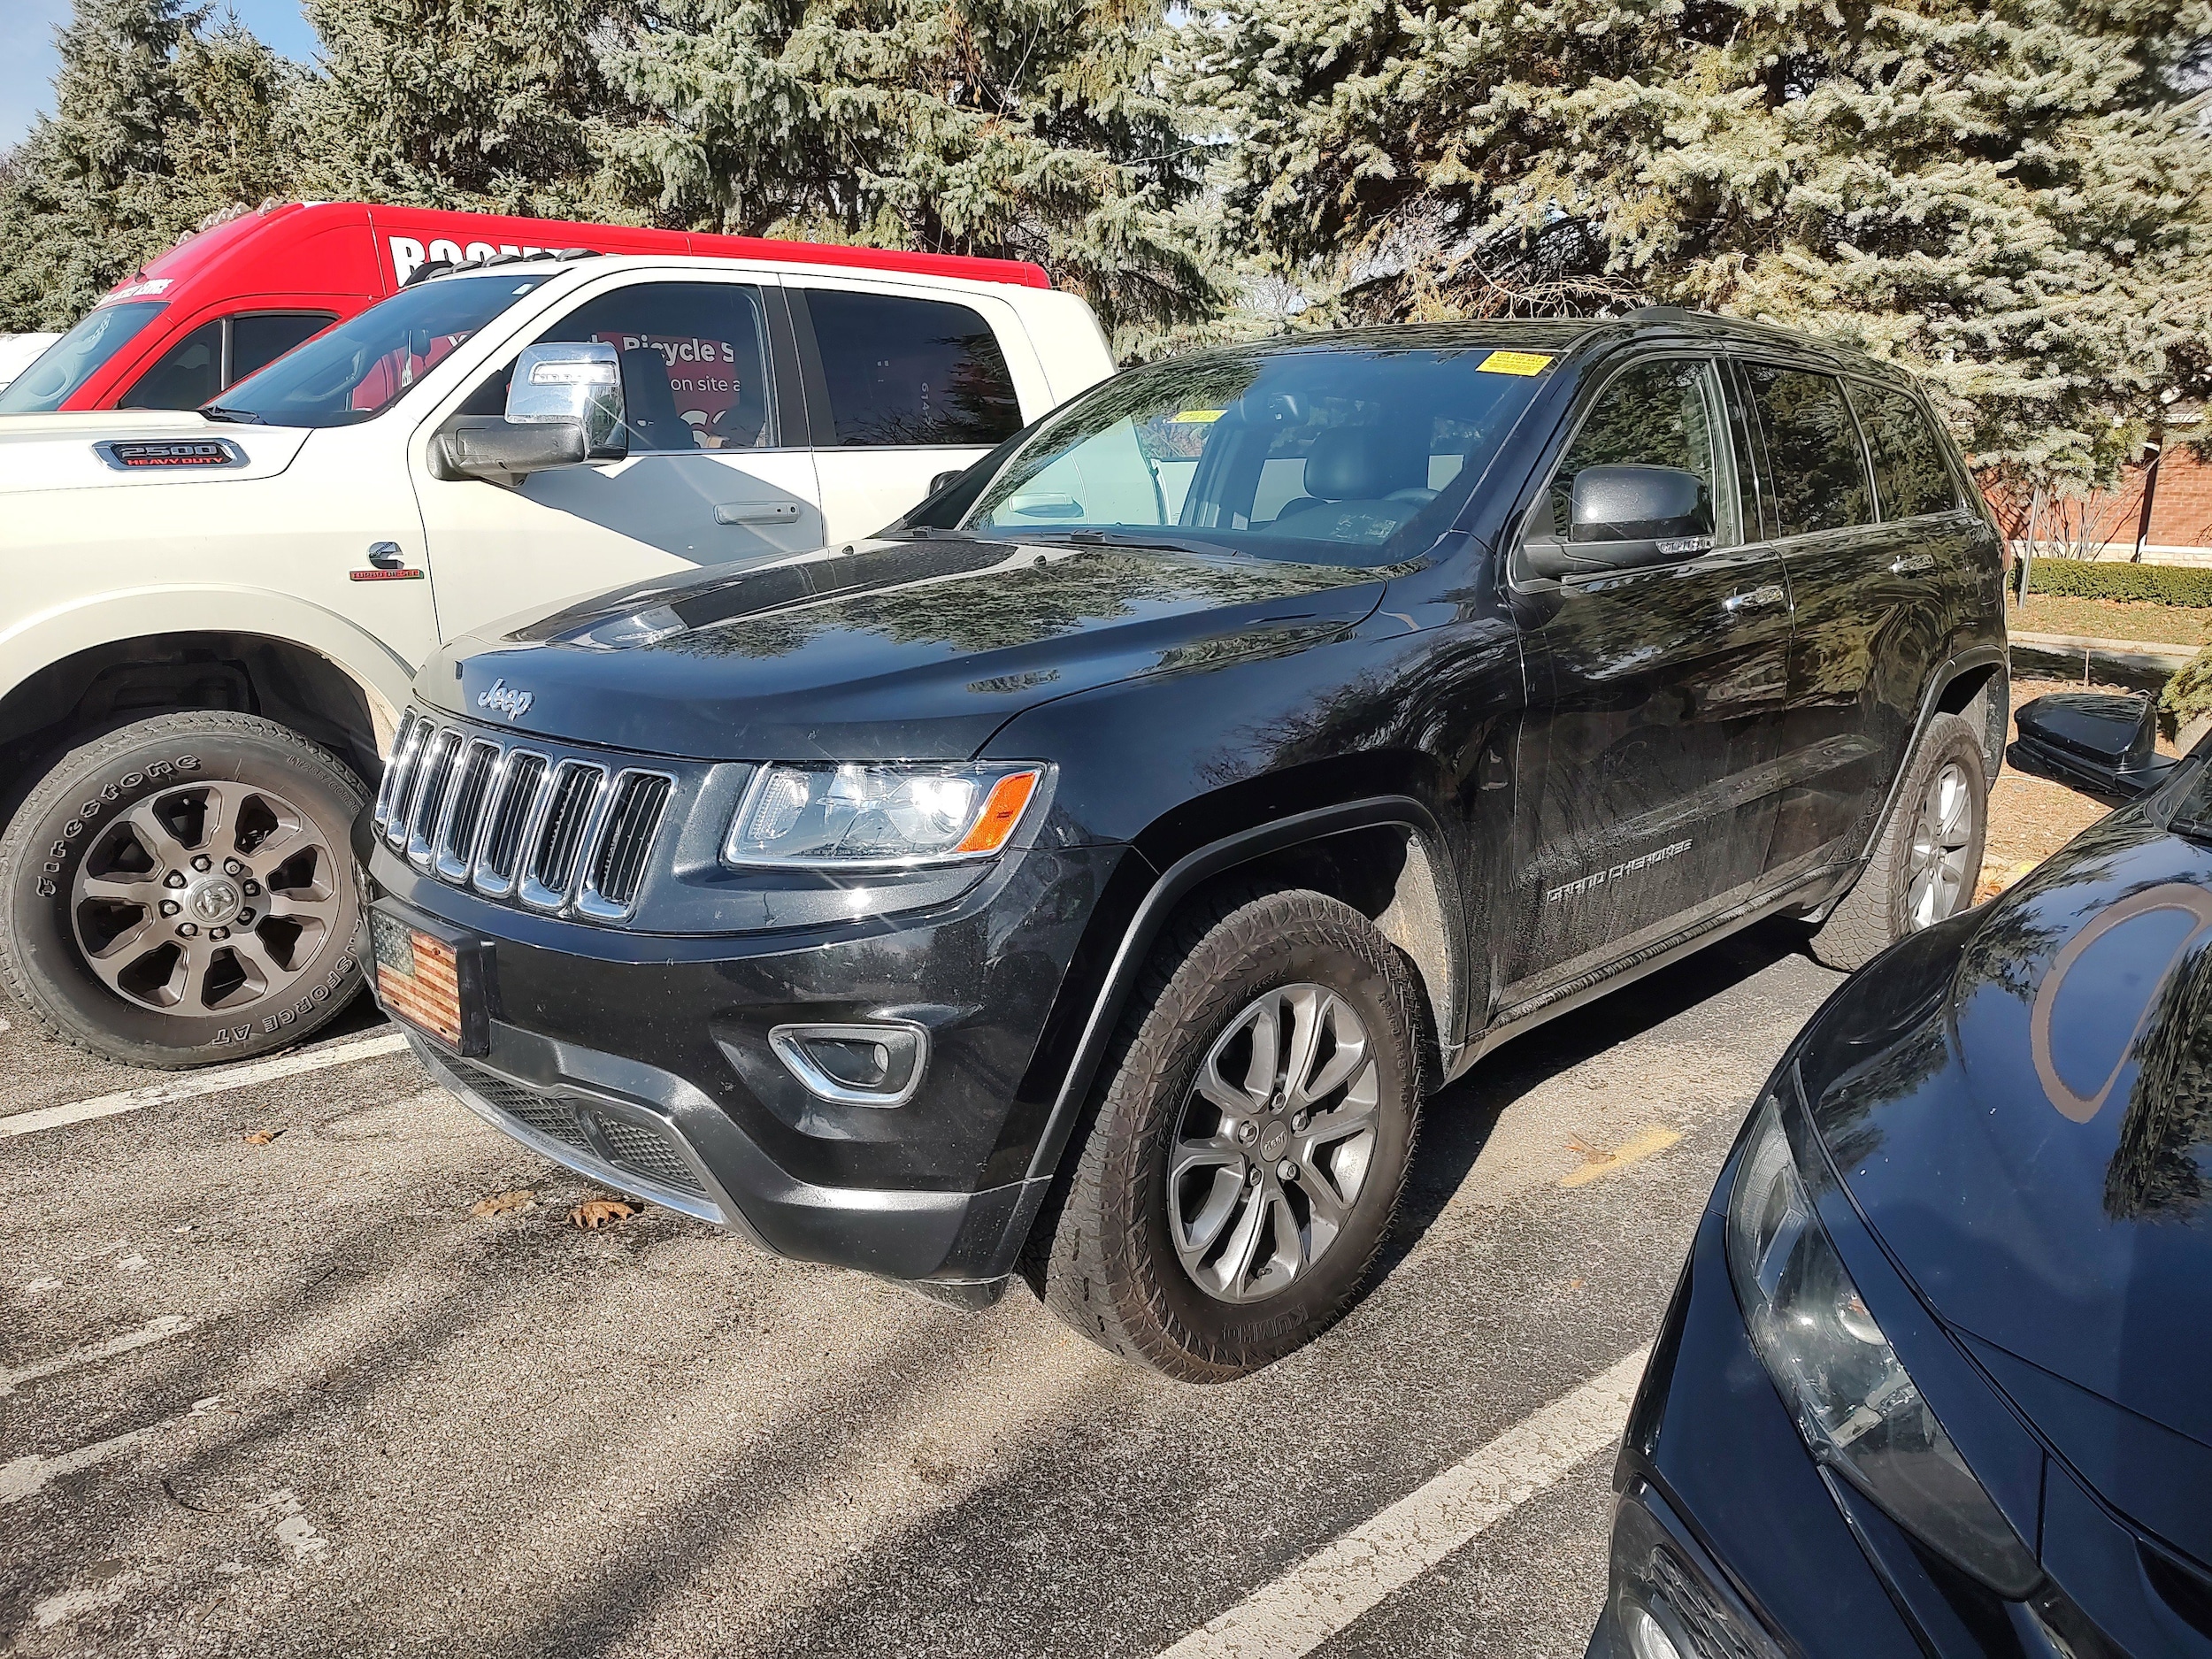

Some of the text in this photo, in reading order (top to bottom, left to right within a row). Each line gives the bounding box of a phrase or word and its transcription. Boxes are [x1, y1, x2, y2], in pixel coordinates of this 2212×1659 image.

[670, 378, 694, 393] on
[697, 375, 729, 393] site
[121, 445, 219, 458] 2500
[127, 457, 224, 466] HEAVY DUTY
[477, 678, 535, 722] Jeep
[1547, 838, 1694, 903] GRAND CHEROKEE
[211, 1022, 254, 1046] AT
[1263, 1130, 1287, 1151] Jeep
[1222, 1302, 1310, 1345] KUMHO
